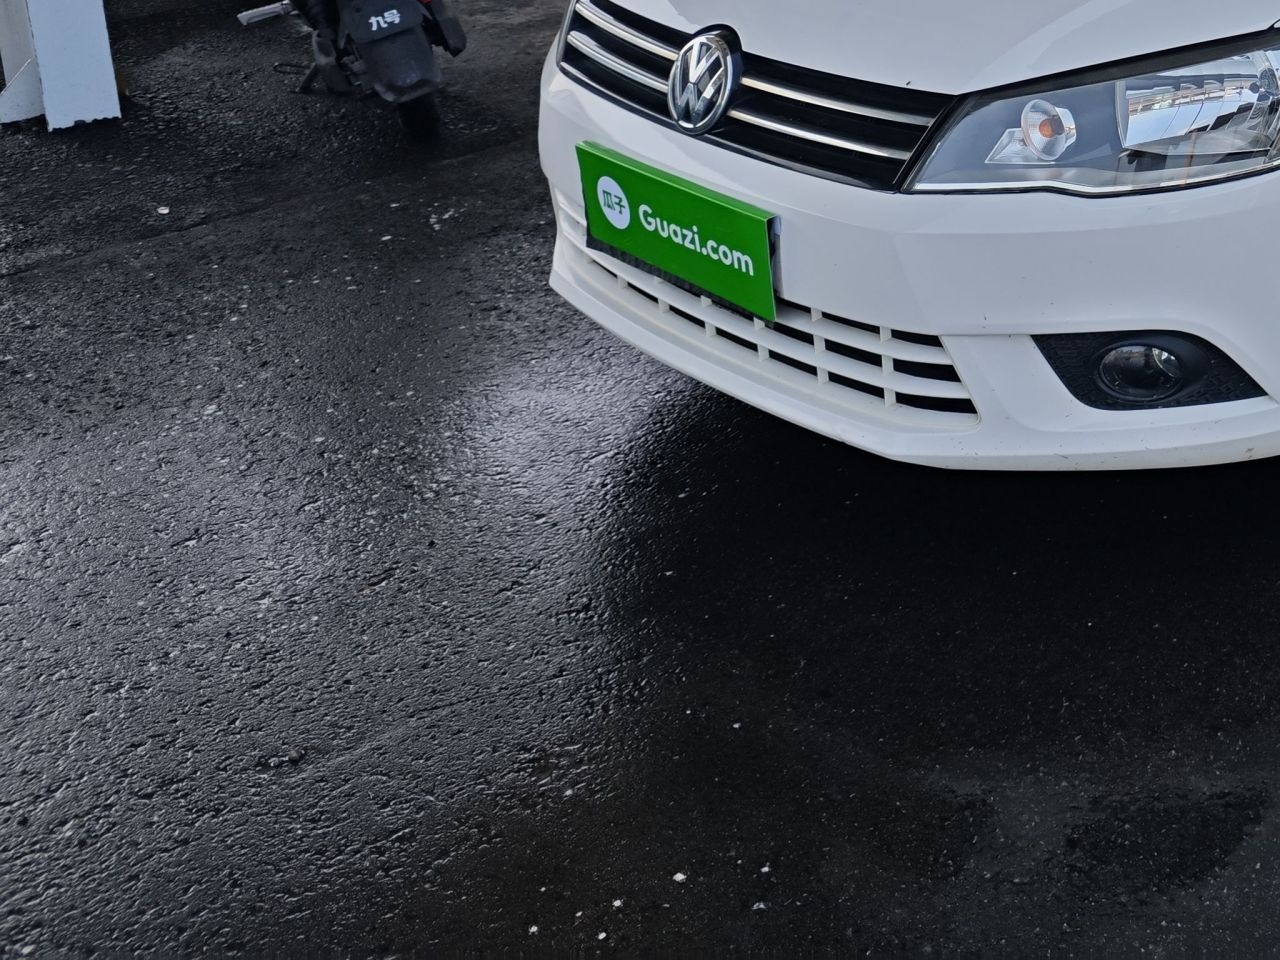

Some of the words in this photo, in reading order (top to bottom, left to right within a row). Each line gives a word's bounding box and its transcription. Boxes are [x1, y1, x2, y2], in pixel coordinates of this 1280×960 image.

[368, 9, 400, 31] 九号
[602, 190, 626, 215] 瓜子
[638, 204, 755, 277] Guazi.com
